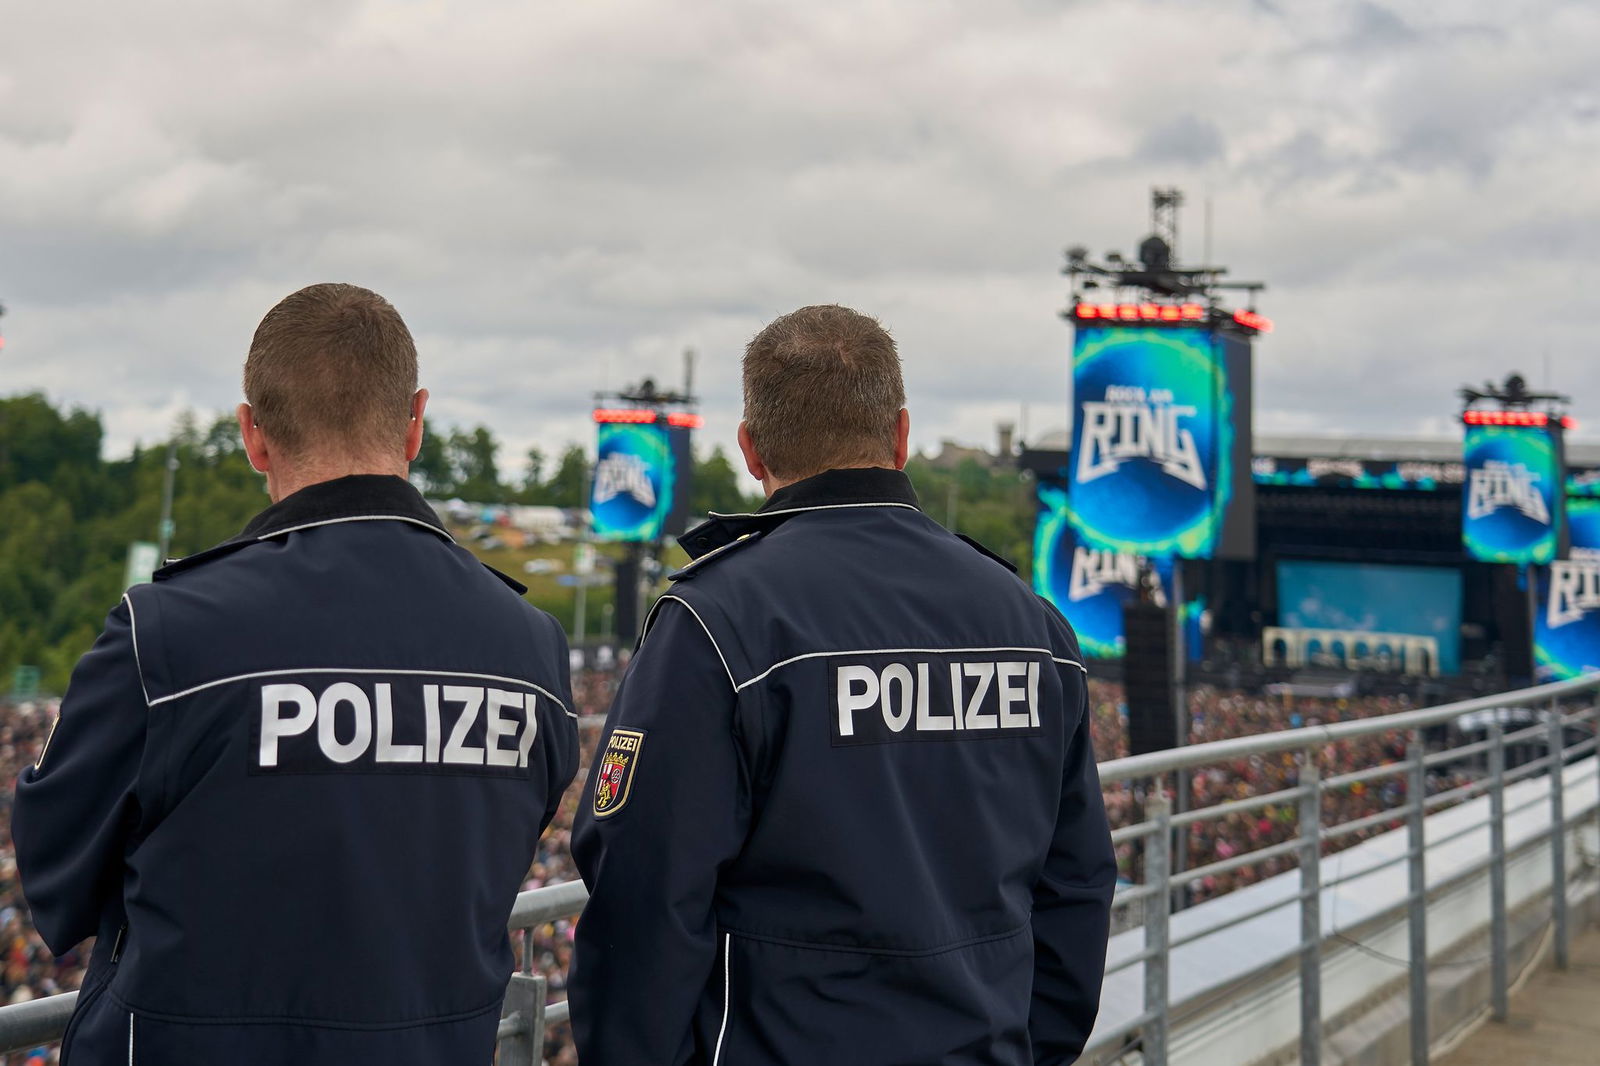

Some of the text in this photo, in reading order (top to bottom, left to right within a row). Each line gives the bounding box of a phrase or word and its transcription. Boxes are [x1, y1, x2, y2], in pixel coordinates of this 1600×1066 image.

[1076, 401, 1207, 491] RING
[259, 682, 538, 768] POLIZEI
[837, 661, 1041, 736] POLIZEI
